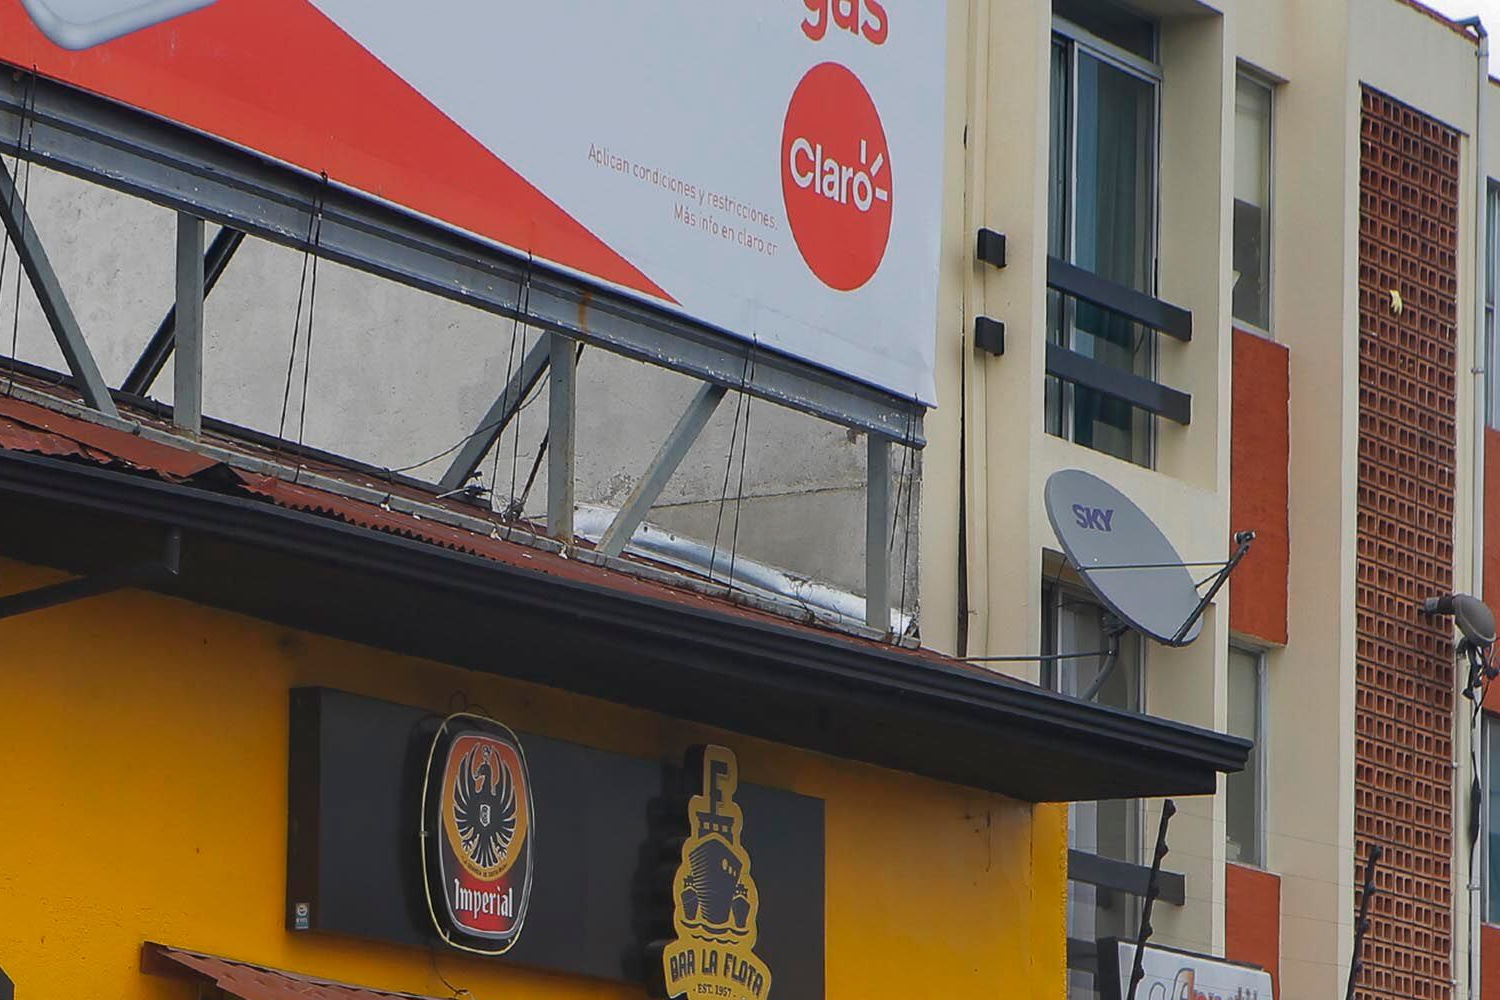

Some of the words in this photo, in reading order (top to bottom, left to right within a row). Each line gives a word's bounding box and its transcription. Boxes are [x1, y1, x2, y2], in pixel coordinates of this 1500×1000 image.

[588, 143, 630, 174] Aplican
[632, 163, 696, 200] condiciones
[698, 187, 706, 206] y
[789, 136, 874, 213] Claro
[674, 203, 696, 227] Más
[699, 211, 719, 236] info
[721, 226, 735, 241] en
[1072, 503, 1114, 533] SKY
[454, 877, 514, 920] Imperial
[669, 948, 696, 983] BAR
[701, 948, 718, 976] LA
[723, 951, 764, 998] FLOTA
